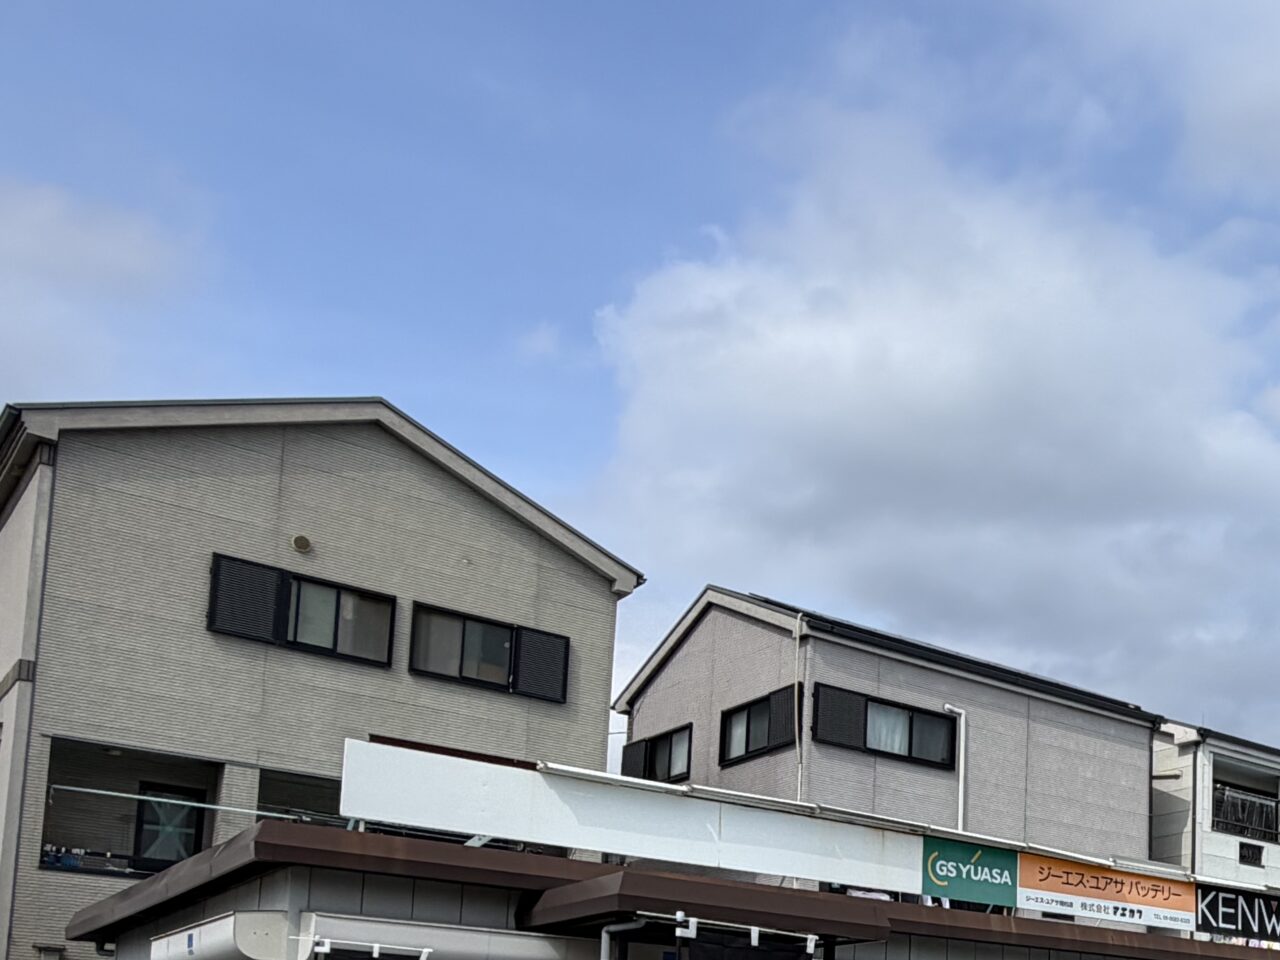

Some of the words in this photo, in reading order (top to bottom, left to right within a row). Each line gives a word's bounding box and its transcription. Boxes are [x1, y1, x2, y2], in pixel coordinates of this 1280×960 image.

[1128, 880, 1182, 901] バッテリー
